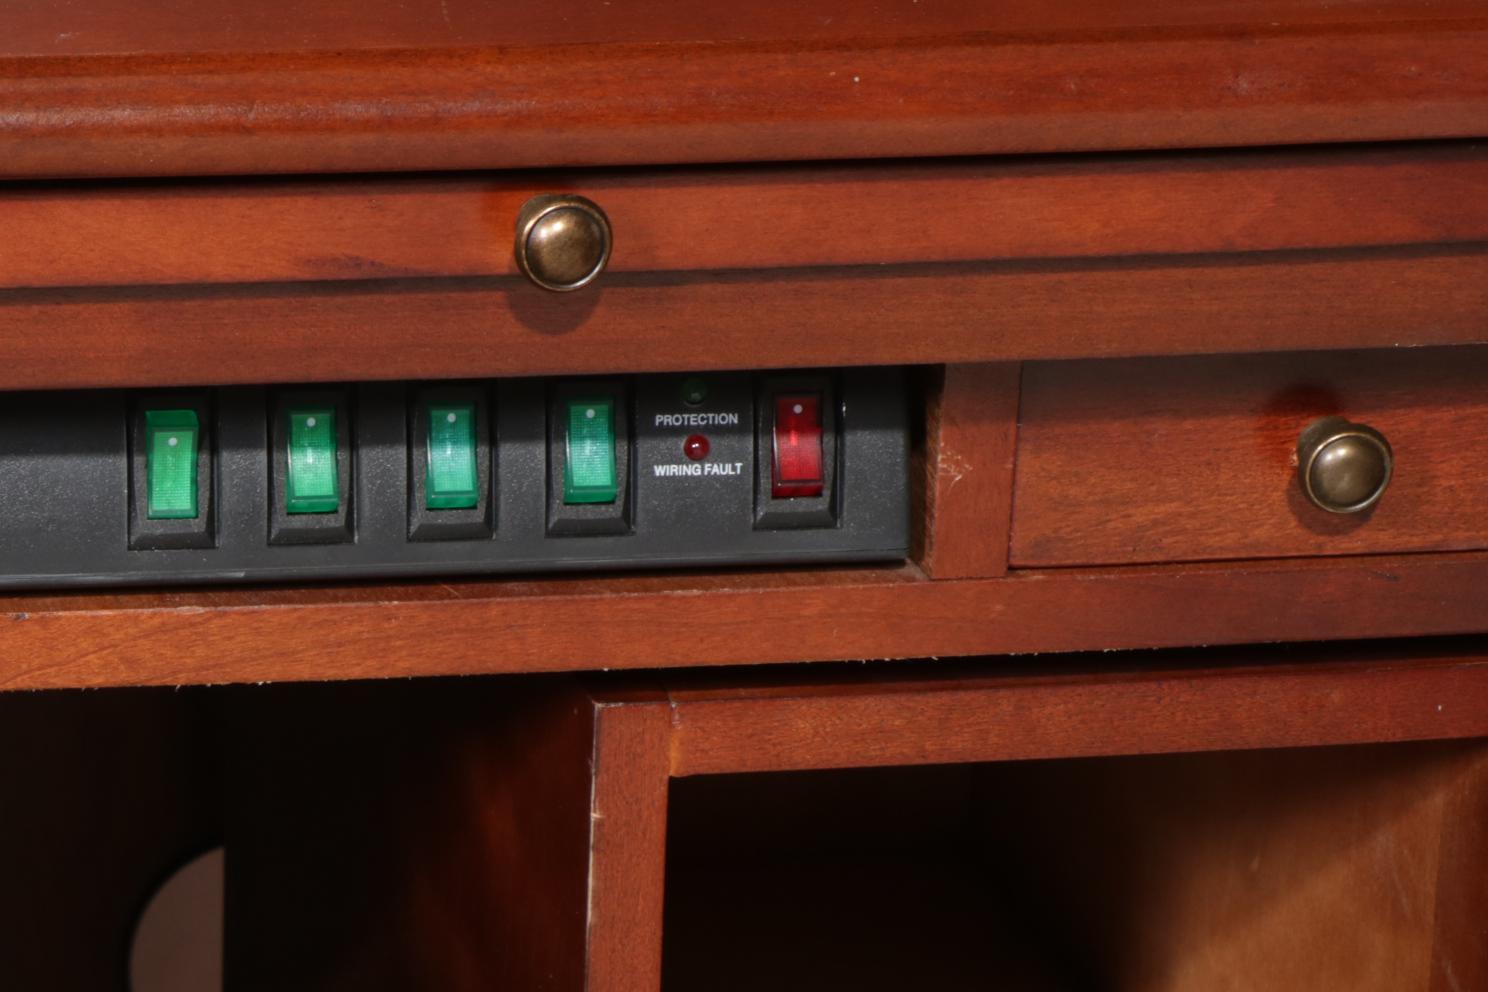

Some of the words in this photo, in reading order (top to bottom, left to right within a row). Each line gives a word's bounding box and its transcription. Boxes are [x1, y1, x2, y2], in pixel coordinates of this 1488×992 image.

[655, 413, 738, 426] PROTECTION
[654, 464, 702, 476] WIRING
[704, 463, 743, 475] FAULT
